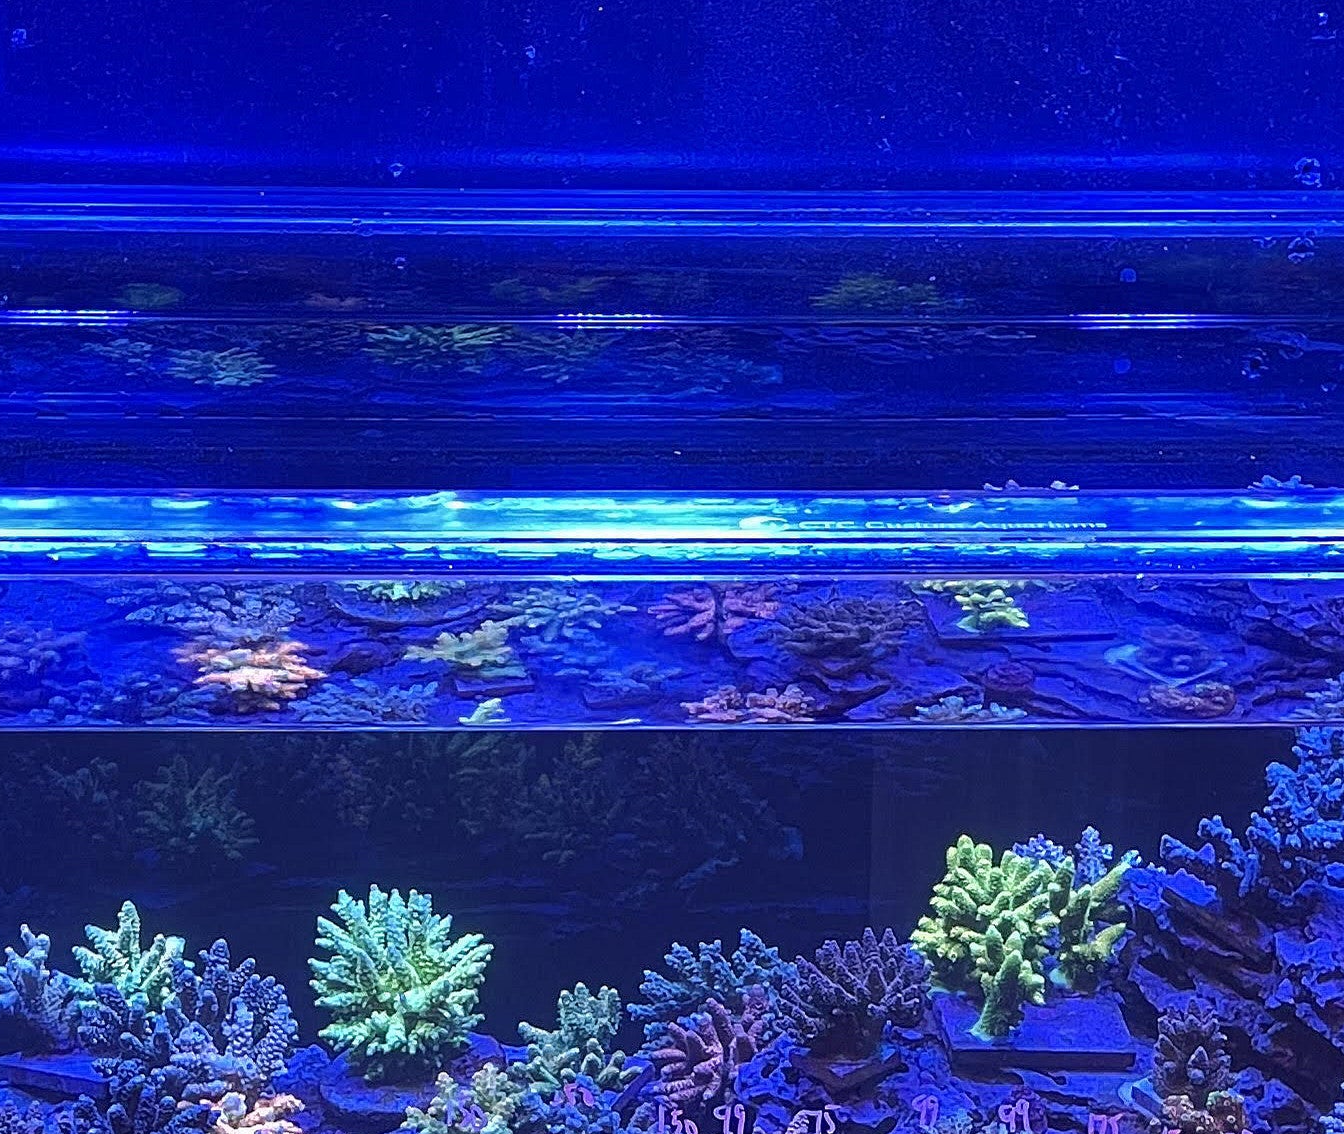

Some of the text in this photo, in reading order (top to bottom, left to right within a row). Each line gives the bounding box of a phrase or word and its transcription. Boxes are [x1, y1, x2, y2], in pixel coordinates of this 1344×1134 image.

[798, 520, 855, 530] CTC
[972, 520, 1108, 531] Aquariums
[998, 1099, 1031, 1133] 99
